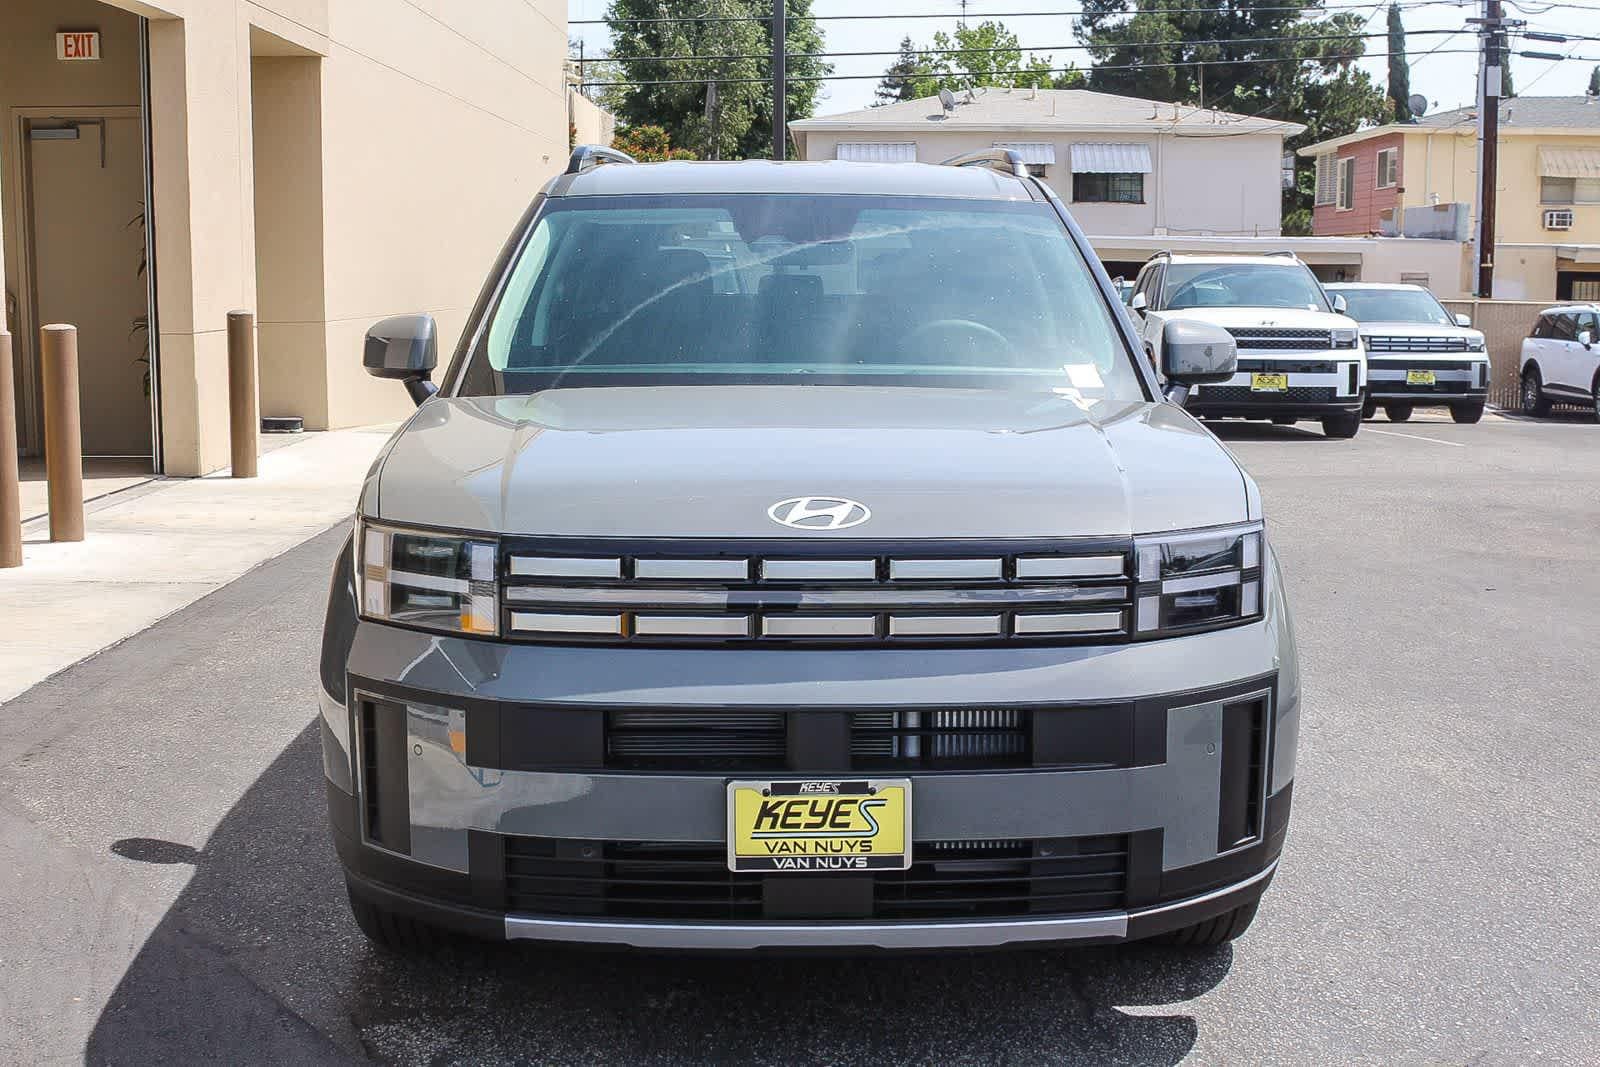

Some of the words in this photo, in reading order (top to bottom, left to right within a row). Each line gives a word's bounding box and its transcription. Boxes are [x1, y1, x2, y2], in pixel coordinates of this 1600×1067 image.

[64, 34, 93, 57] EXIT
[799, 782, 840, 792] KEYES
[752, 799, 888, 838] KEYES
[764, 840, 807, 853] VAN
[815, 840, 872, 853] NUYS
[773, 857, 809, 868] VAN
[816, 857, 868, 868] NUYS
